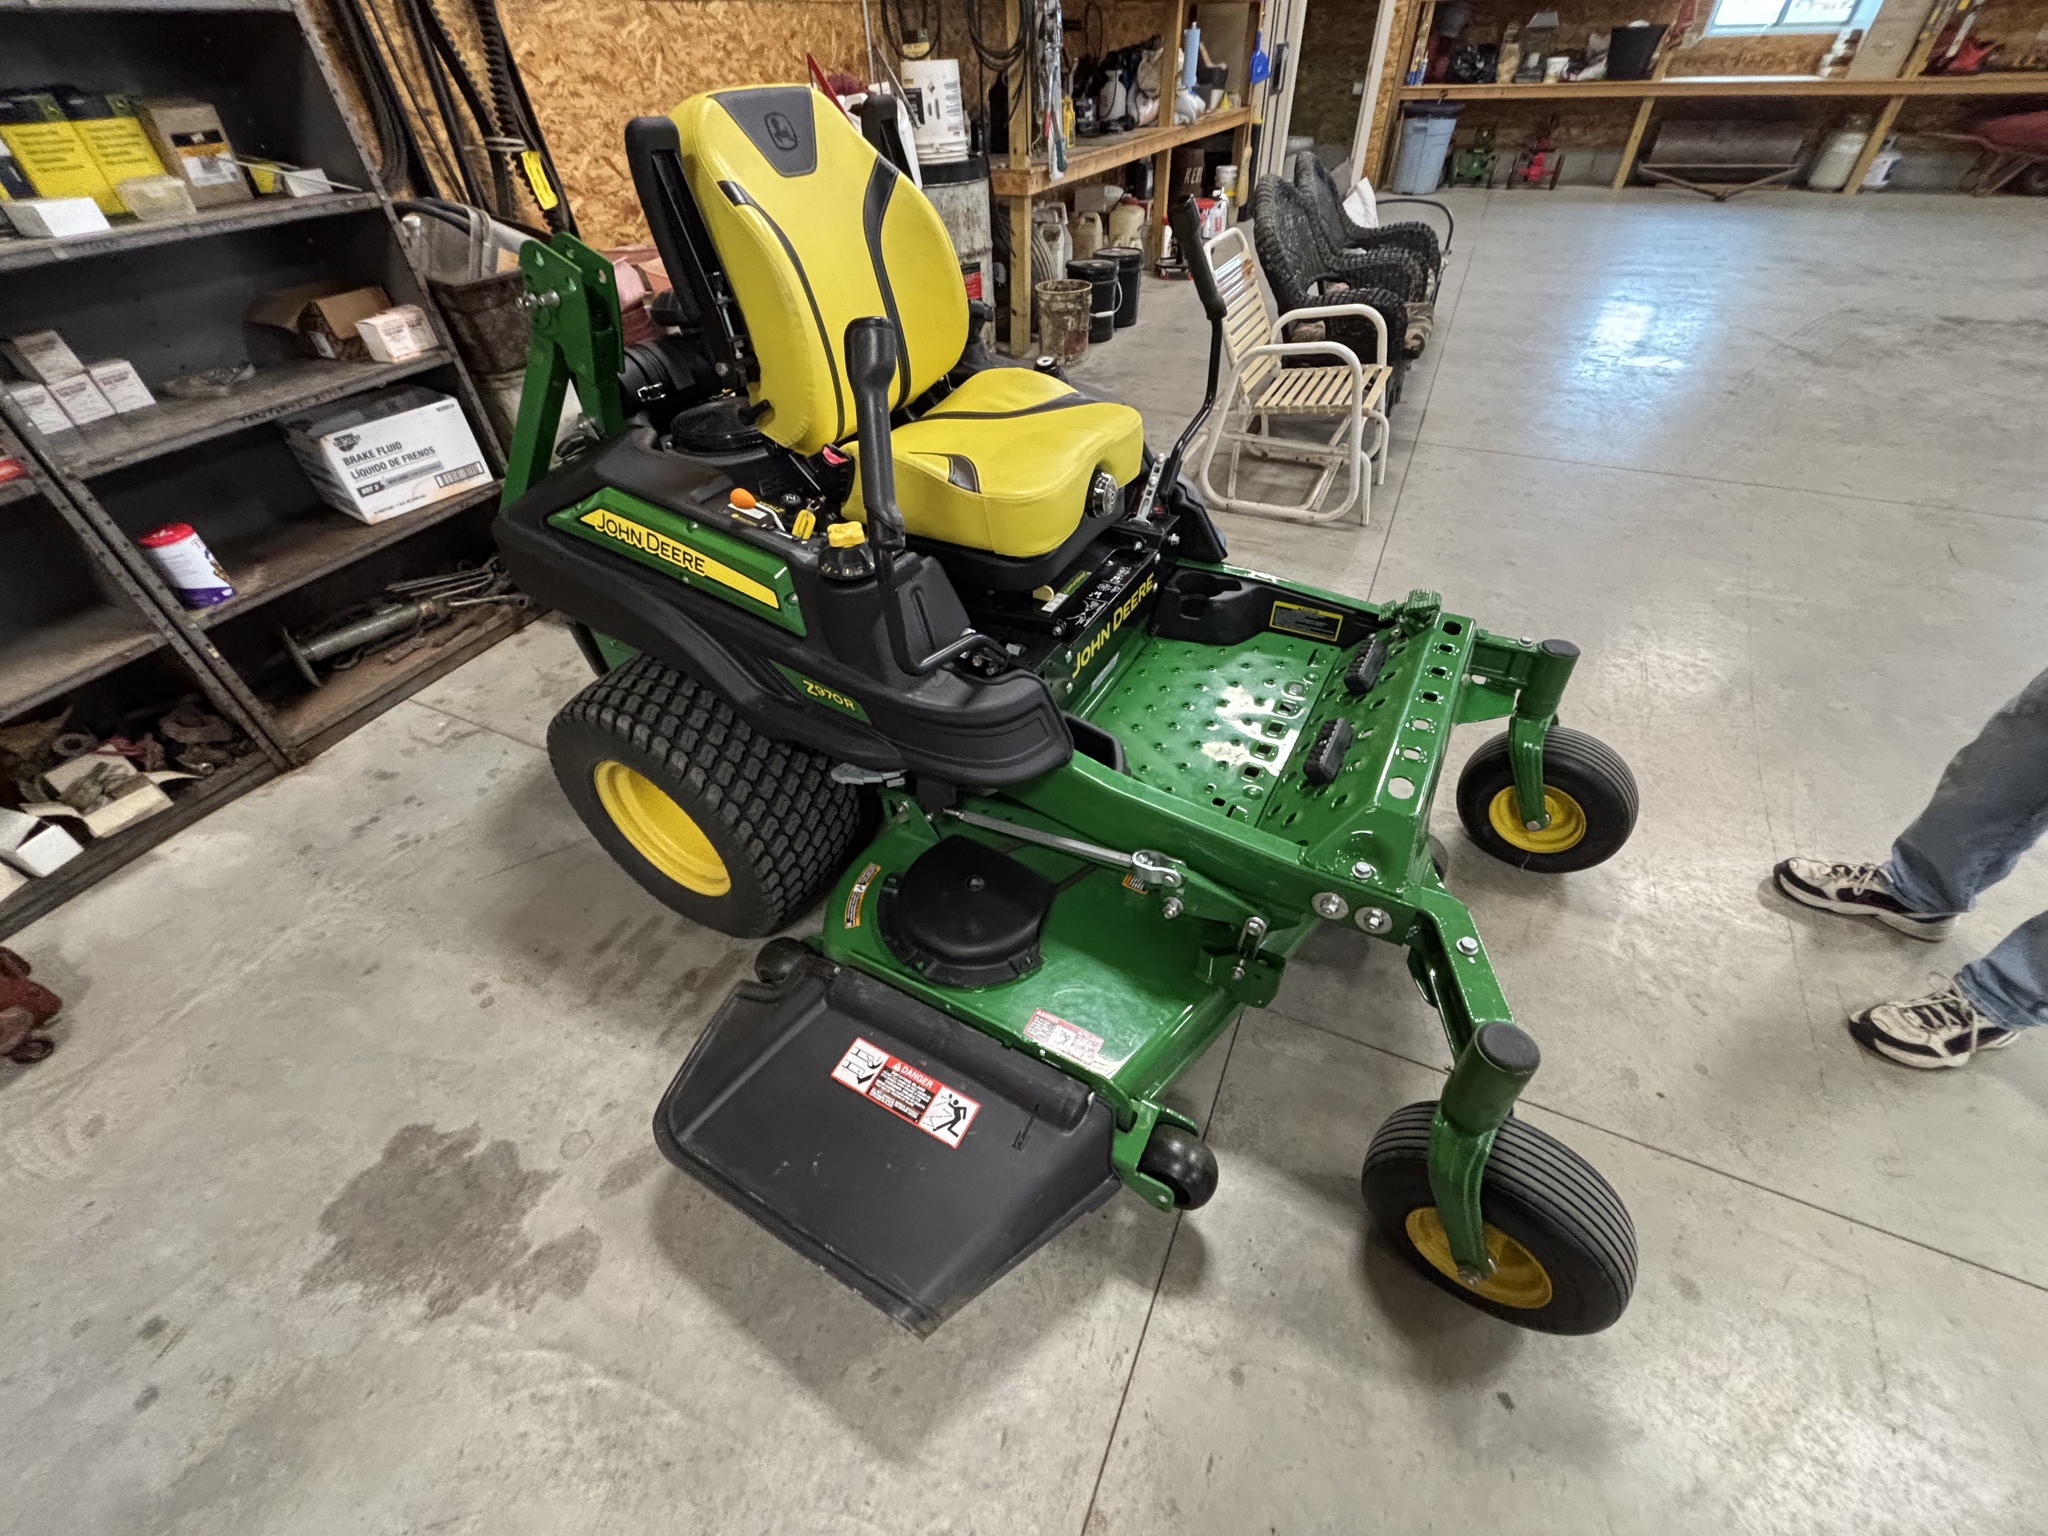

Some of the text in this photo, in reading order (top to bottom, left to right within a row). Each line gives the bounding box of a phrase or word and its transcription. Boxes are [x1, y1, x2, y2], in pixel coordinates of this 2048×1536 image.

[343, 449, 376, 467] BRAKE
[376, 441, 402, 457] FLUID
[351, 462, 388, 480] LÍQUIDO
[388, 457, 401, 468] DE
[402, 446, 436, 463] FRENOS
[597, 512, 706, 575] JOHN DEERE
[1072, 572, 1154, 679] JOHN DEERE
[803, 680, 855, 711] Z970R
[901, 1065, 934, 1089] DANGER
